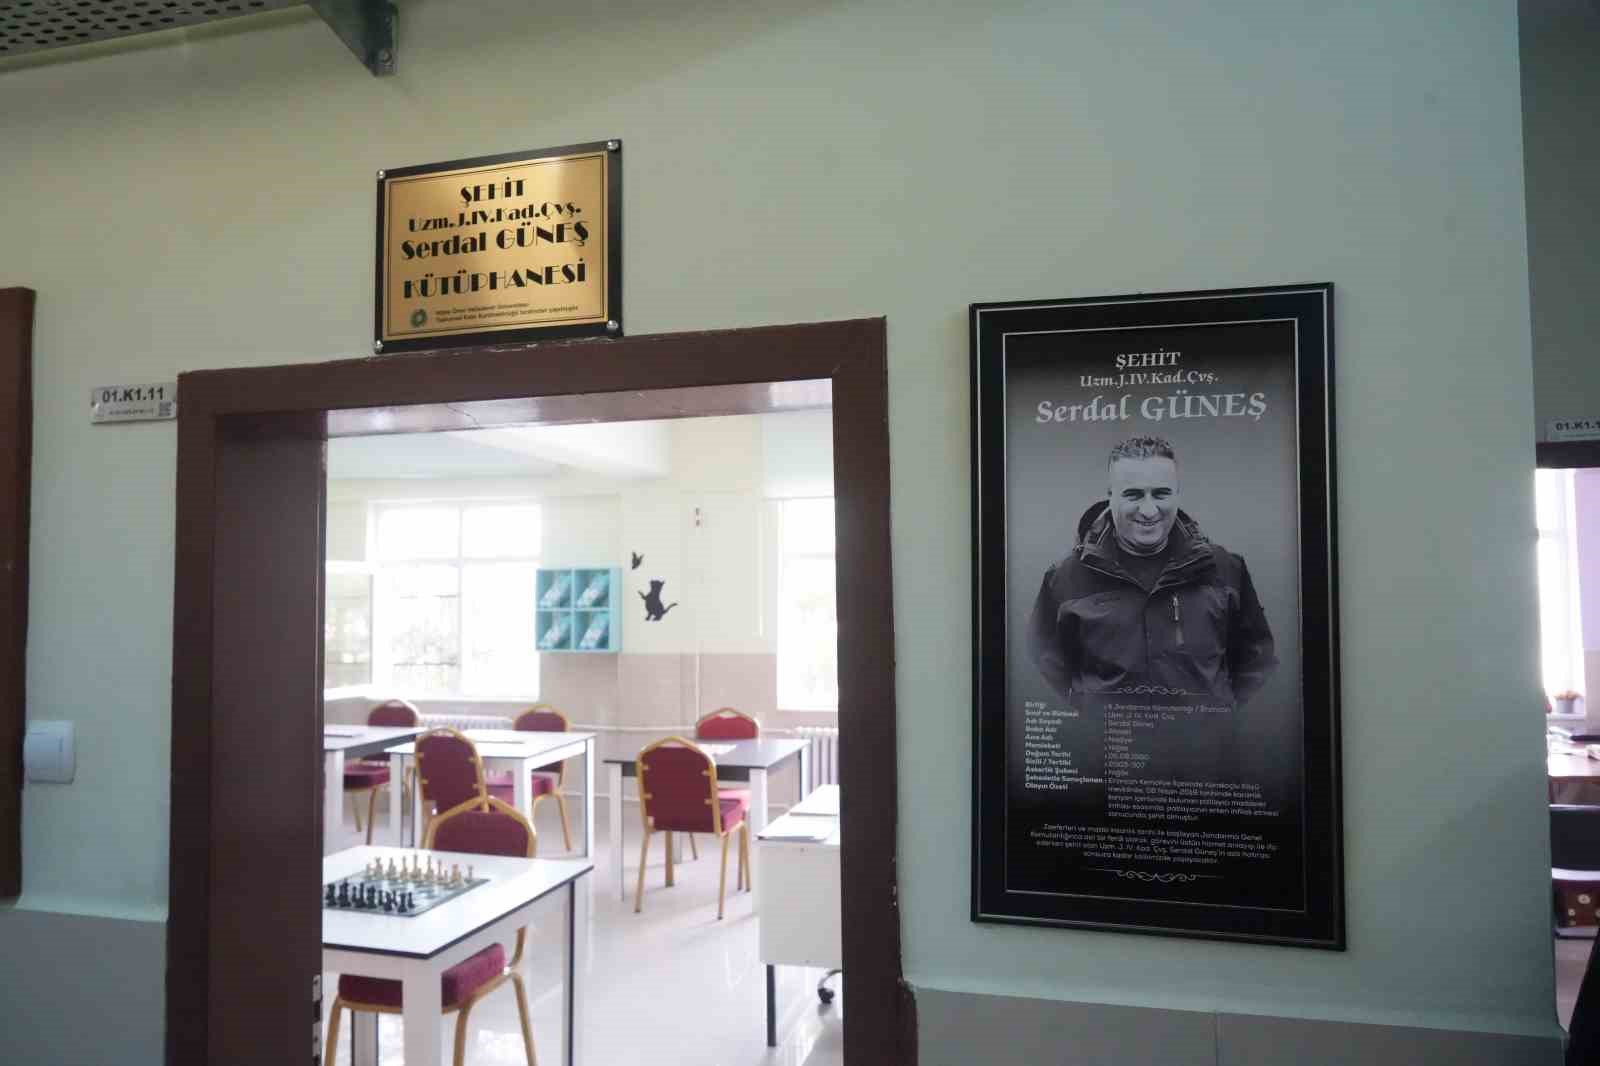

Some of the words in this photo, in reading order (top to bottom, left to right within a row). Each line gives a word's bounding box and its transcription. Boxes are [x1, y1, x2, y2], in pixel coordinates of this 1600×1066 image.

[460, 177, 527, 206] ŞEHİT
[401, 232, 486, 260] Serdal
[496, 221, 589, 250] GÜNEŞ
[404, 258, 586, 298] KÜTÜPHANESİ
[1116, 348, 1181, 370] ŞEHİT
[102, 387, 163, 403] 01.K1.11
[1036, 394, 1132, 423] Serdal
[1141, 389, 1267, 421] GÜNEŞ
